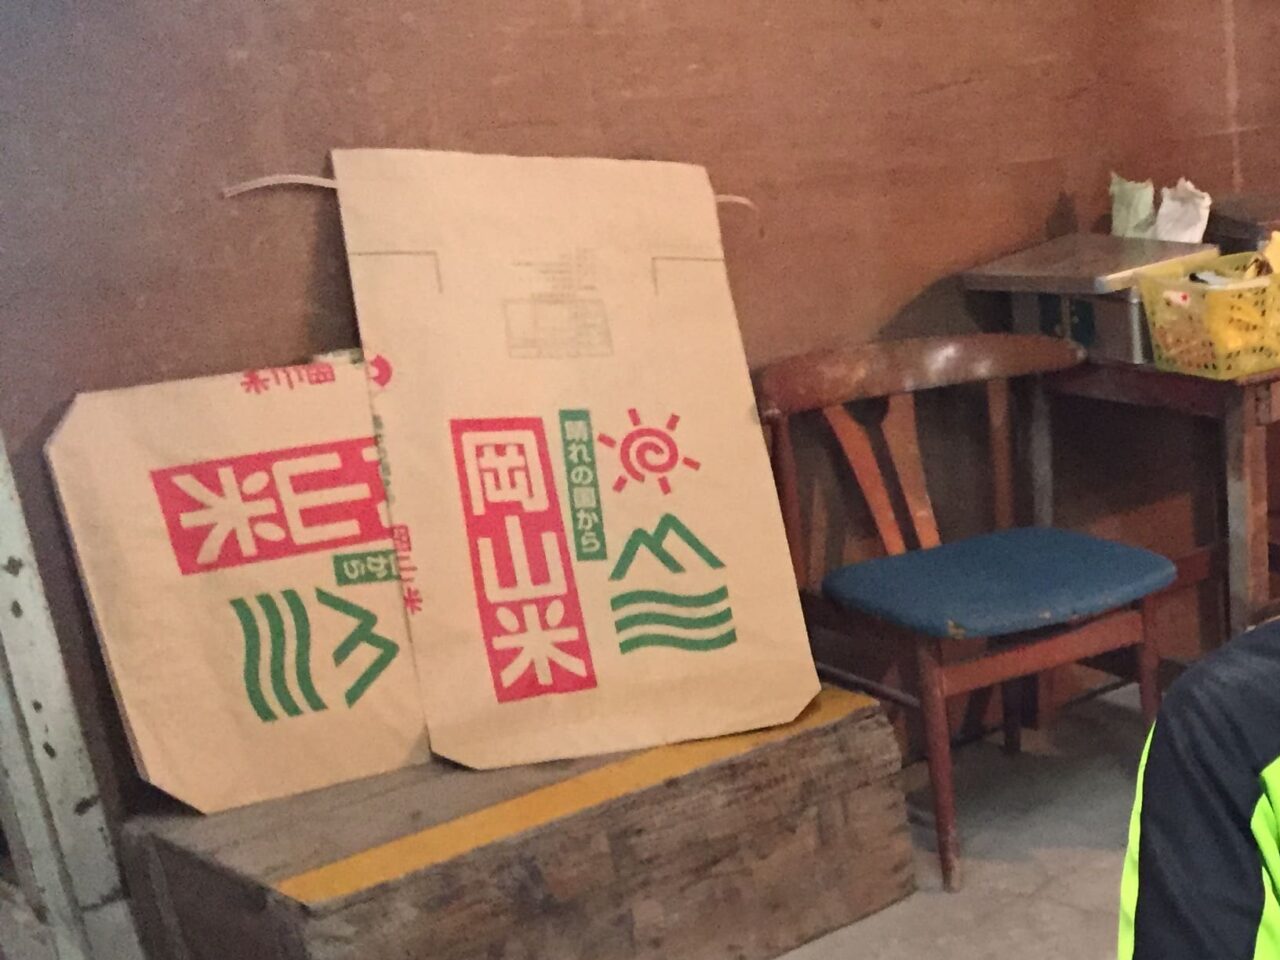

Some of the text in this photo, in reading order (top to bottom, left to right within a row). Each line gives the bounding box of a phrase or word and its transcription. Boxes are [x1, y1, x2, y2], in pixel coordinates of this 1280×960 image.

[171, 446, 393, 565] 山米
[461, 429, 588, 687] 岡山米
[344, 553, 397, 580] から
